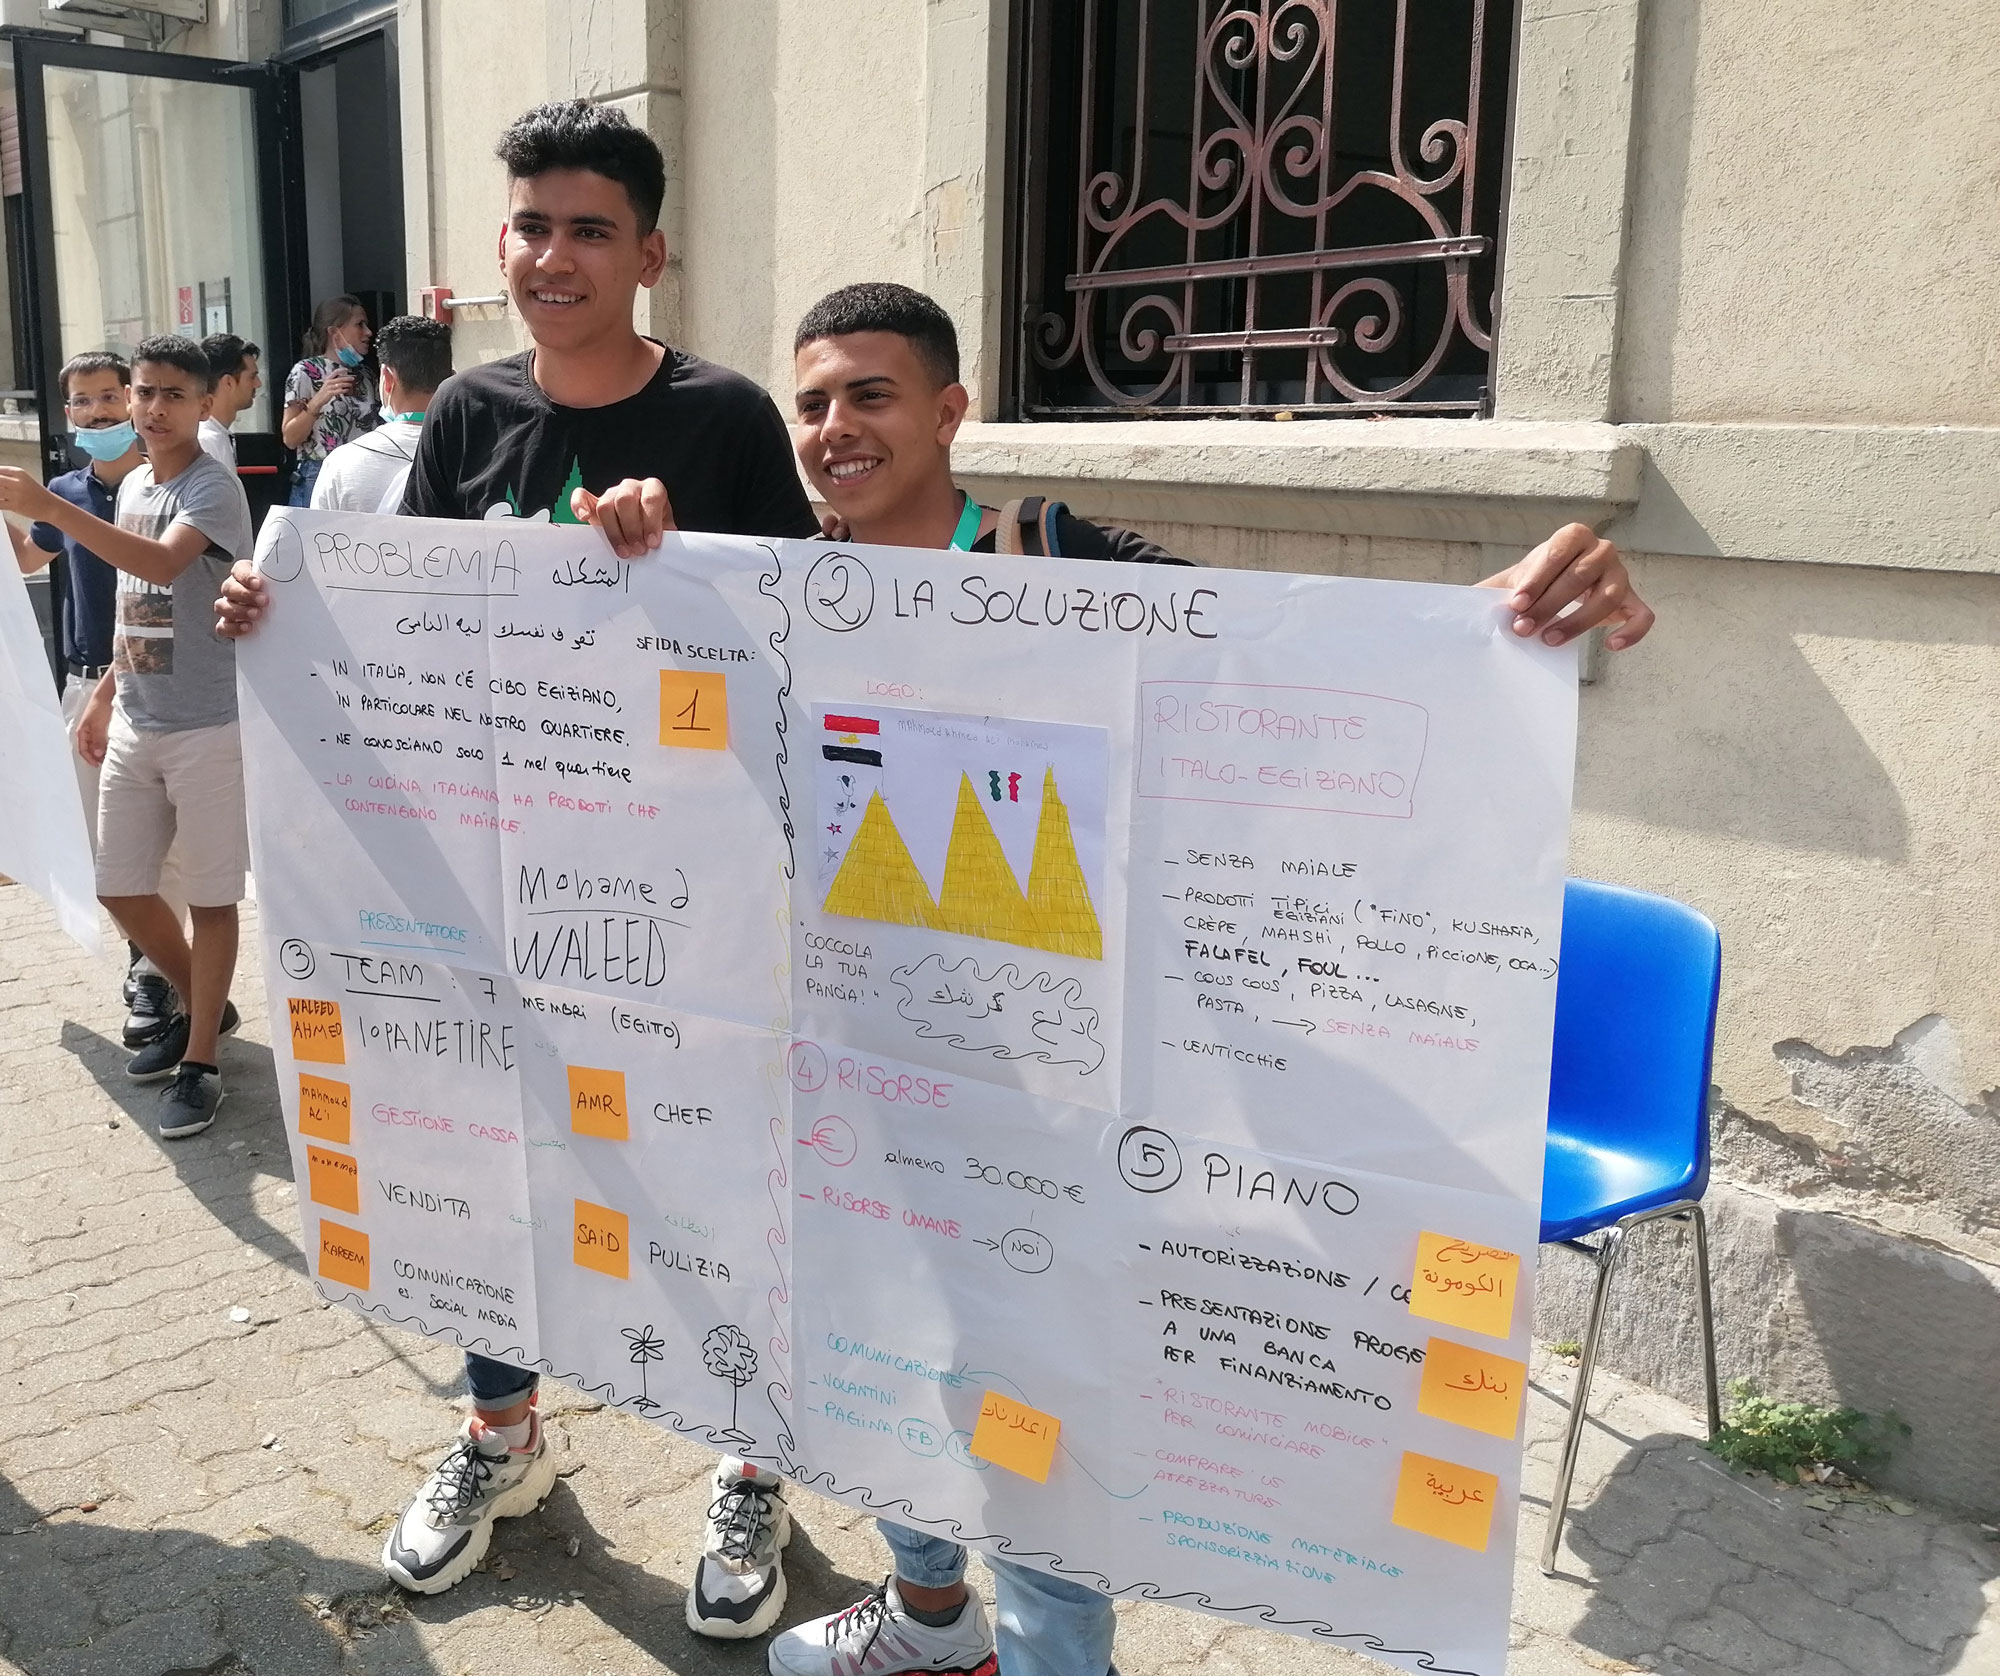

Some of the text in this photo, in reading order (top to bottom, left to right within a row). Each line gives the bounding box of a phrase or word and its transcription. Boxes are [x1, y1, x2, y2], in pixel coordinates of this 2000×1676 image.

[313, 532, 522, 591] PROBLEMA
[818, 565, 862, 625] 2
[894, 575, 1219, 639] LA SOLUZIONE
[636, 635, 757, 662] SFIDA SCELTA:
[332, 659, 348, 677] IN
[362, 663, 413, 686] ITALIA,
[421, 671, 446, 686] NON
[488, 678, 527, 696] CIBO
[537, 681, 623, 714] EGIZIANO,
[336, 690, 630, 748] IN PARTICOLARE NEL NOSTRO QUARTIERE.
[677, 689, 710, 732] 1
[1153, 694, 1368, 740] RISTORANTE
[336, 732, 351, 746] NE
[363, 736, 443, 754] CONOSCIAMO
[456, 746, 484, 761] SOLO
[501, 751, 515, 767] 1
[555, 760, 633, 784] quartiere
[336, 772, 353, 786] LA
[368, 774, 422, 793] CUCINA
[433, 781, 500, 804] ITALIANA
[513, 793, 534, 808] HA
[627, 801, 661, 820] CHE
[344, 798, 526, 835] CONTENGONO MAIALE.
[1186, 849, 1358, 878] SENZA MAIALE
[1184, 886, 1255, 907] PRODOTTI
[1271, 895, 1330, 913] TIPICI
[1273, 909, 1345, 925] EGIZIANI
[288, 943, 311, 973] 3
[513, 917, 667, 987] WALEED
[805, 954, 868, 979] LA TUA
[1261, 925, 1345, 954] MAHSHI,
[1356, 934, 1422, 960] POLLO,
[1426, 945, 1502, 974] PICCIONE,
[289, 999, 335, 1017] WALEED
[478, 977, 497, 1005] 7
[522, 996, 587, 1021] MEMBRI
[611, 1005, 681, 1050] (EGITTO)
[1193, 970, 1234, 986] COUS
[1311, 982, 1377, 1013] PIZZA,
[1385, 993, 1477, 1028] LASAGNE,
[293, 1019, 342, 1040] AHMED
[1196, 993, 1481, 1053] PASTA, SENZA MAIALE
[796, 1056, 814, 1087] 4
[1183, 1039, 1288, 1072] LENTICCHIE
[576, 1091, 622, 1118] AMR
[837, 1057, 954, 1108] RISORSE
[371, 1102, 519, 1144] GESTIONE CASSA
[654, 1102, 713, 1126] CHEF
[884, 1149, 945, 1174] almeno
[1130, 1142, 1166, 1178] 5
[378, 1179, 472, 1220] VENDITA
[1204, 1153, 1360, 1216] PIANO
[822, 1186, 962, 1240] RISORSE UMANE
[322, 1239, 366, 1267] KAREEM
[577, 1222, 621, 1252] SAID
[1011, 1239, 1041, 1257] NOI
[393, 1258, 516, 1305] COMUNICAZIONE
[649, 1241, 732, 1283] PULIZIA
[1161, 1239, 1351, 1289] AUTORIZZAZIONE
[429, 1293, 469, 1318] SOCIAL
[478, 1308, 519, 1331] MEDIA
[1160, 1289, 1332, 1341] PRESENTAZIONE
[827, 1332, 963, 1389] COMUNICAZIONE
[1163, 1321, 1336, 1373] A UNA BANCA
[823, 1372, 898, 1405] VOLANTINI
[1163, 1345, 1392, 1411] PER FINANZIAMENTO
[824, 1401, 893, 1435] PAGINA
[906, 1427, 933, 1446] FB
[1164, 1408, 1326, 1459] PER COMINCIARE
[1155, 1449, 1245, 1478] COMPRARE
[1163, 1510, 1404, 1578] PRODUZIONE MATERIALE
